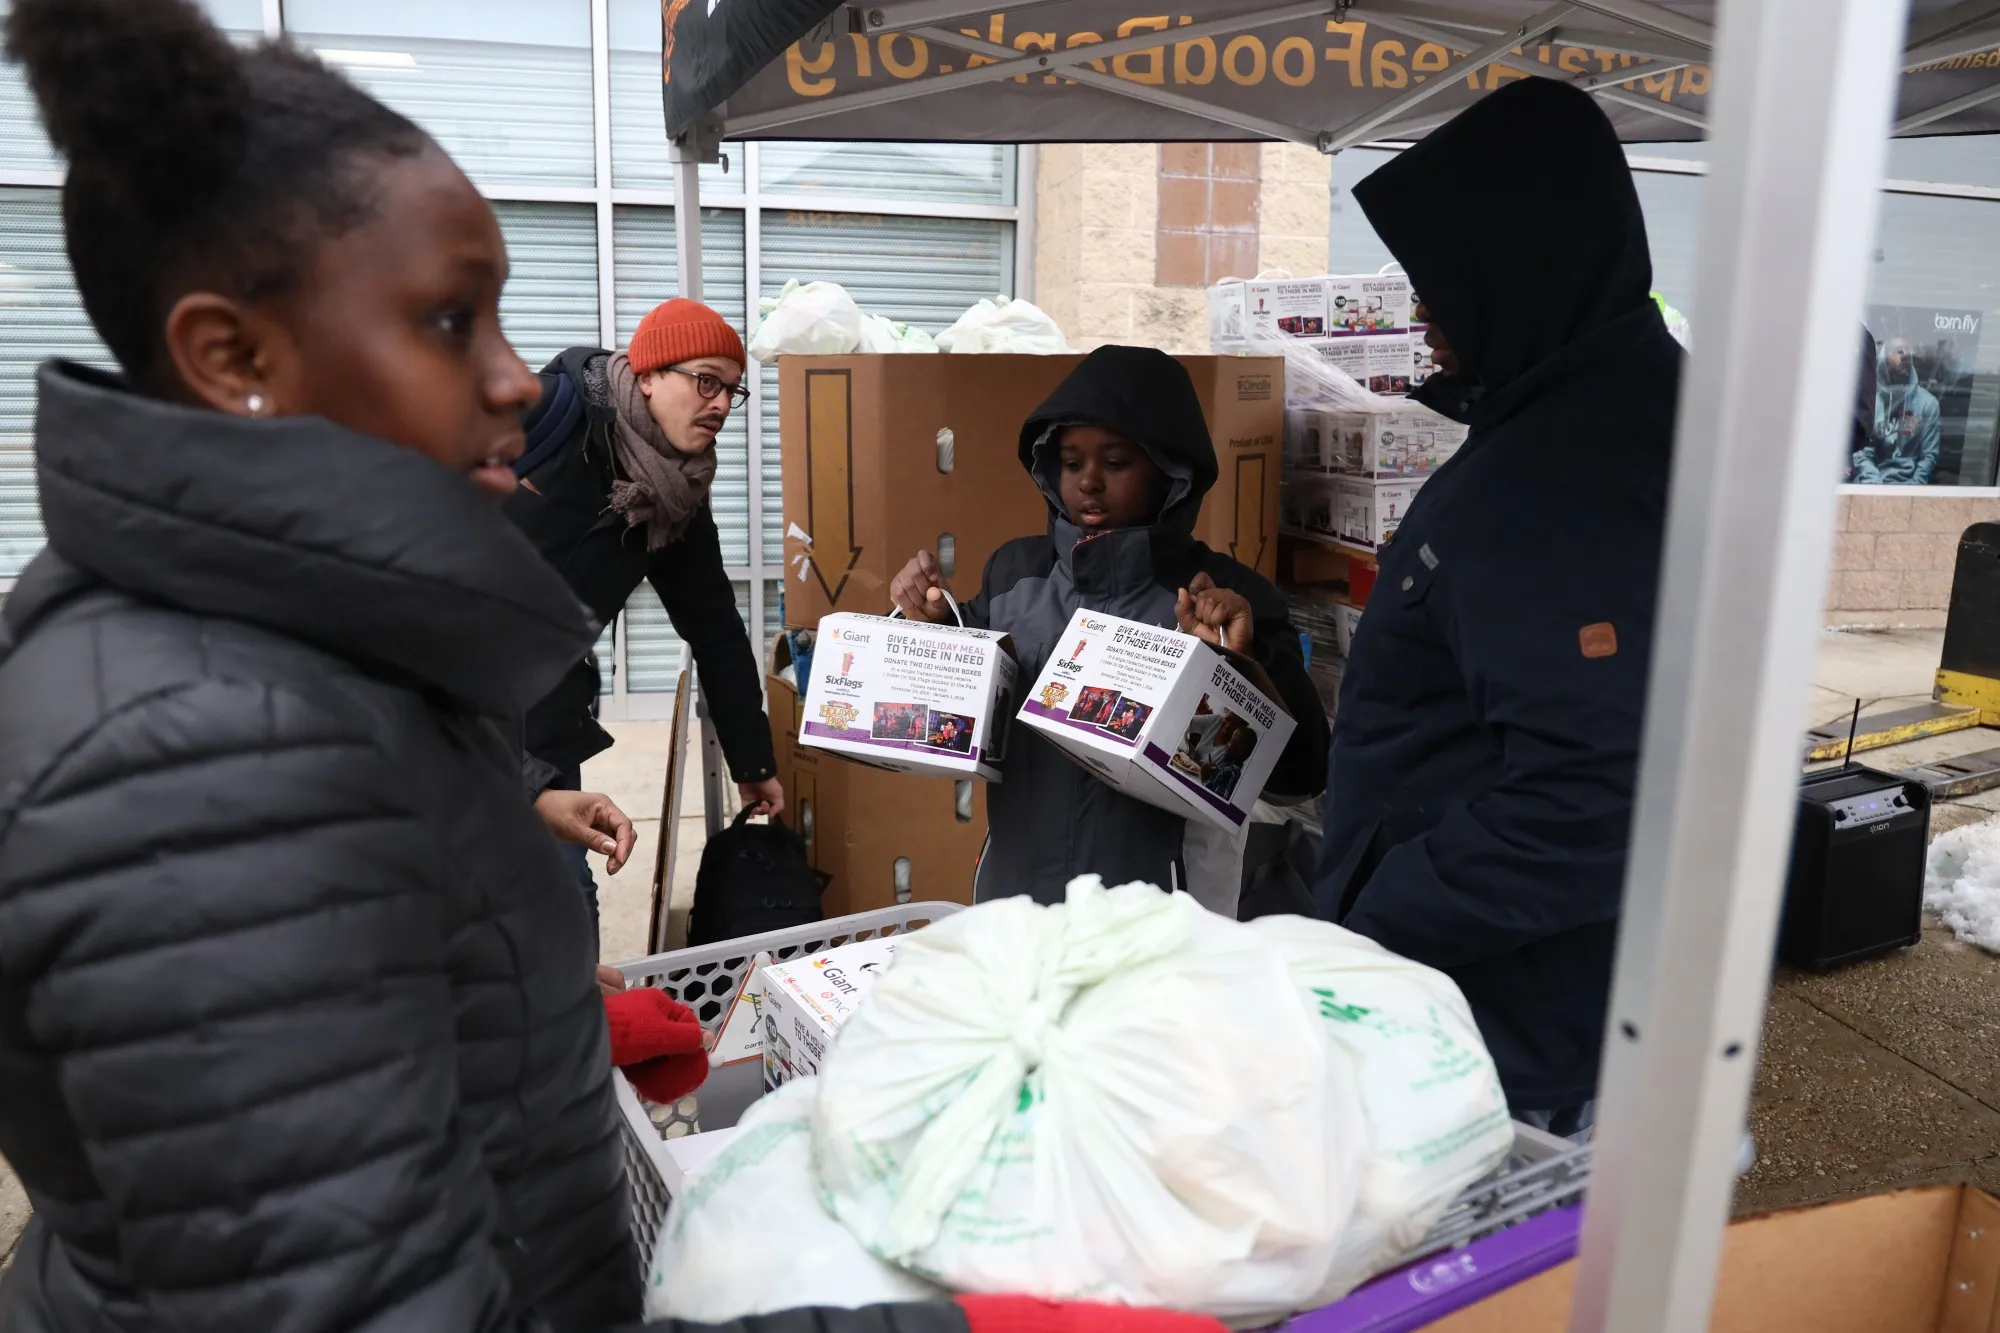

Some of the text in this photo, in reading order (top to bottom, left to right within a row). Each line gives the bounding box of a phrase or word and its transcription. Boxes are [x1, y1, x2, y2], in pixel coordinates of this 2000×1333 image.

[1086, 619, 1106, 632] Giant
[843, 630, 870, 643] Giant
[888, 634, 908, 644] GIVE
[919, 639, 958, 652] HOLIDAY
[960, 645, 985, 655] MEAL
[1112, 633, 1184, 658] TO THOSE IN NEED
[1117, 626, 1134, 635] GIVE
[1140, 631, 1169, 644] HOLIDAY
[1168, 638, 1188, 649] MEAL
[884, 657, 907, 665] DONATE
[935, 665, 959, 673] HUNGER
[887, 644, 984, 665] TO THOSE IN NEED
[1057, 658, 1084, 672] SixFlags
[1106, 646, 1123, 654] DONATE
[1142, 655, 1160, 664] HUNGER
[1160, 660, 1176, 668] BOXES
[825, 675, 863, 689] SixFlags
[1216, 664, 1276, 721] GIVE A HOLIDAY MEAL
[1211, 672, 1273, 729] TO THOSE IN NEED
[823, 968, 858, 995] Giant
[768, 992, 782, 1013] Giant
[828, 997, 850, 1013] PNC
[794, 1017, 826, 1054] GIVE A HOLID
[794, 1026, 822, 1061] TO THOSE
